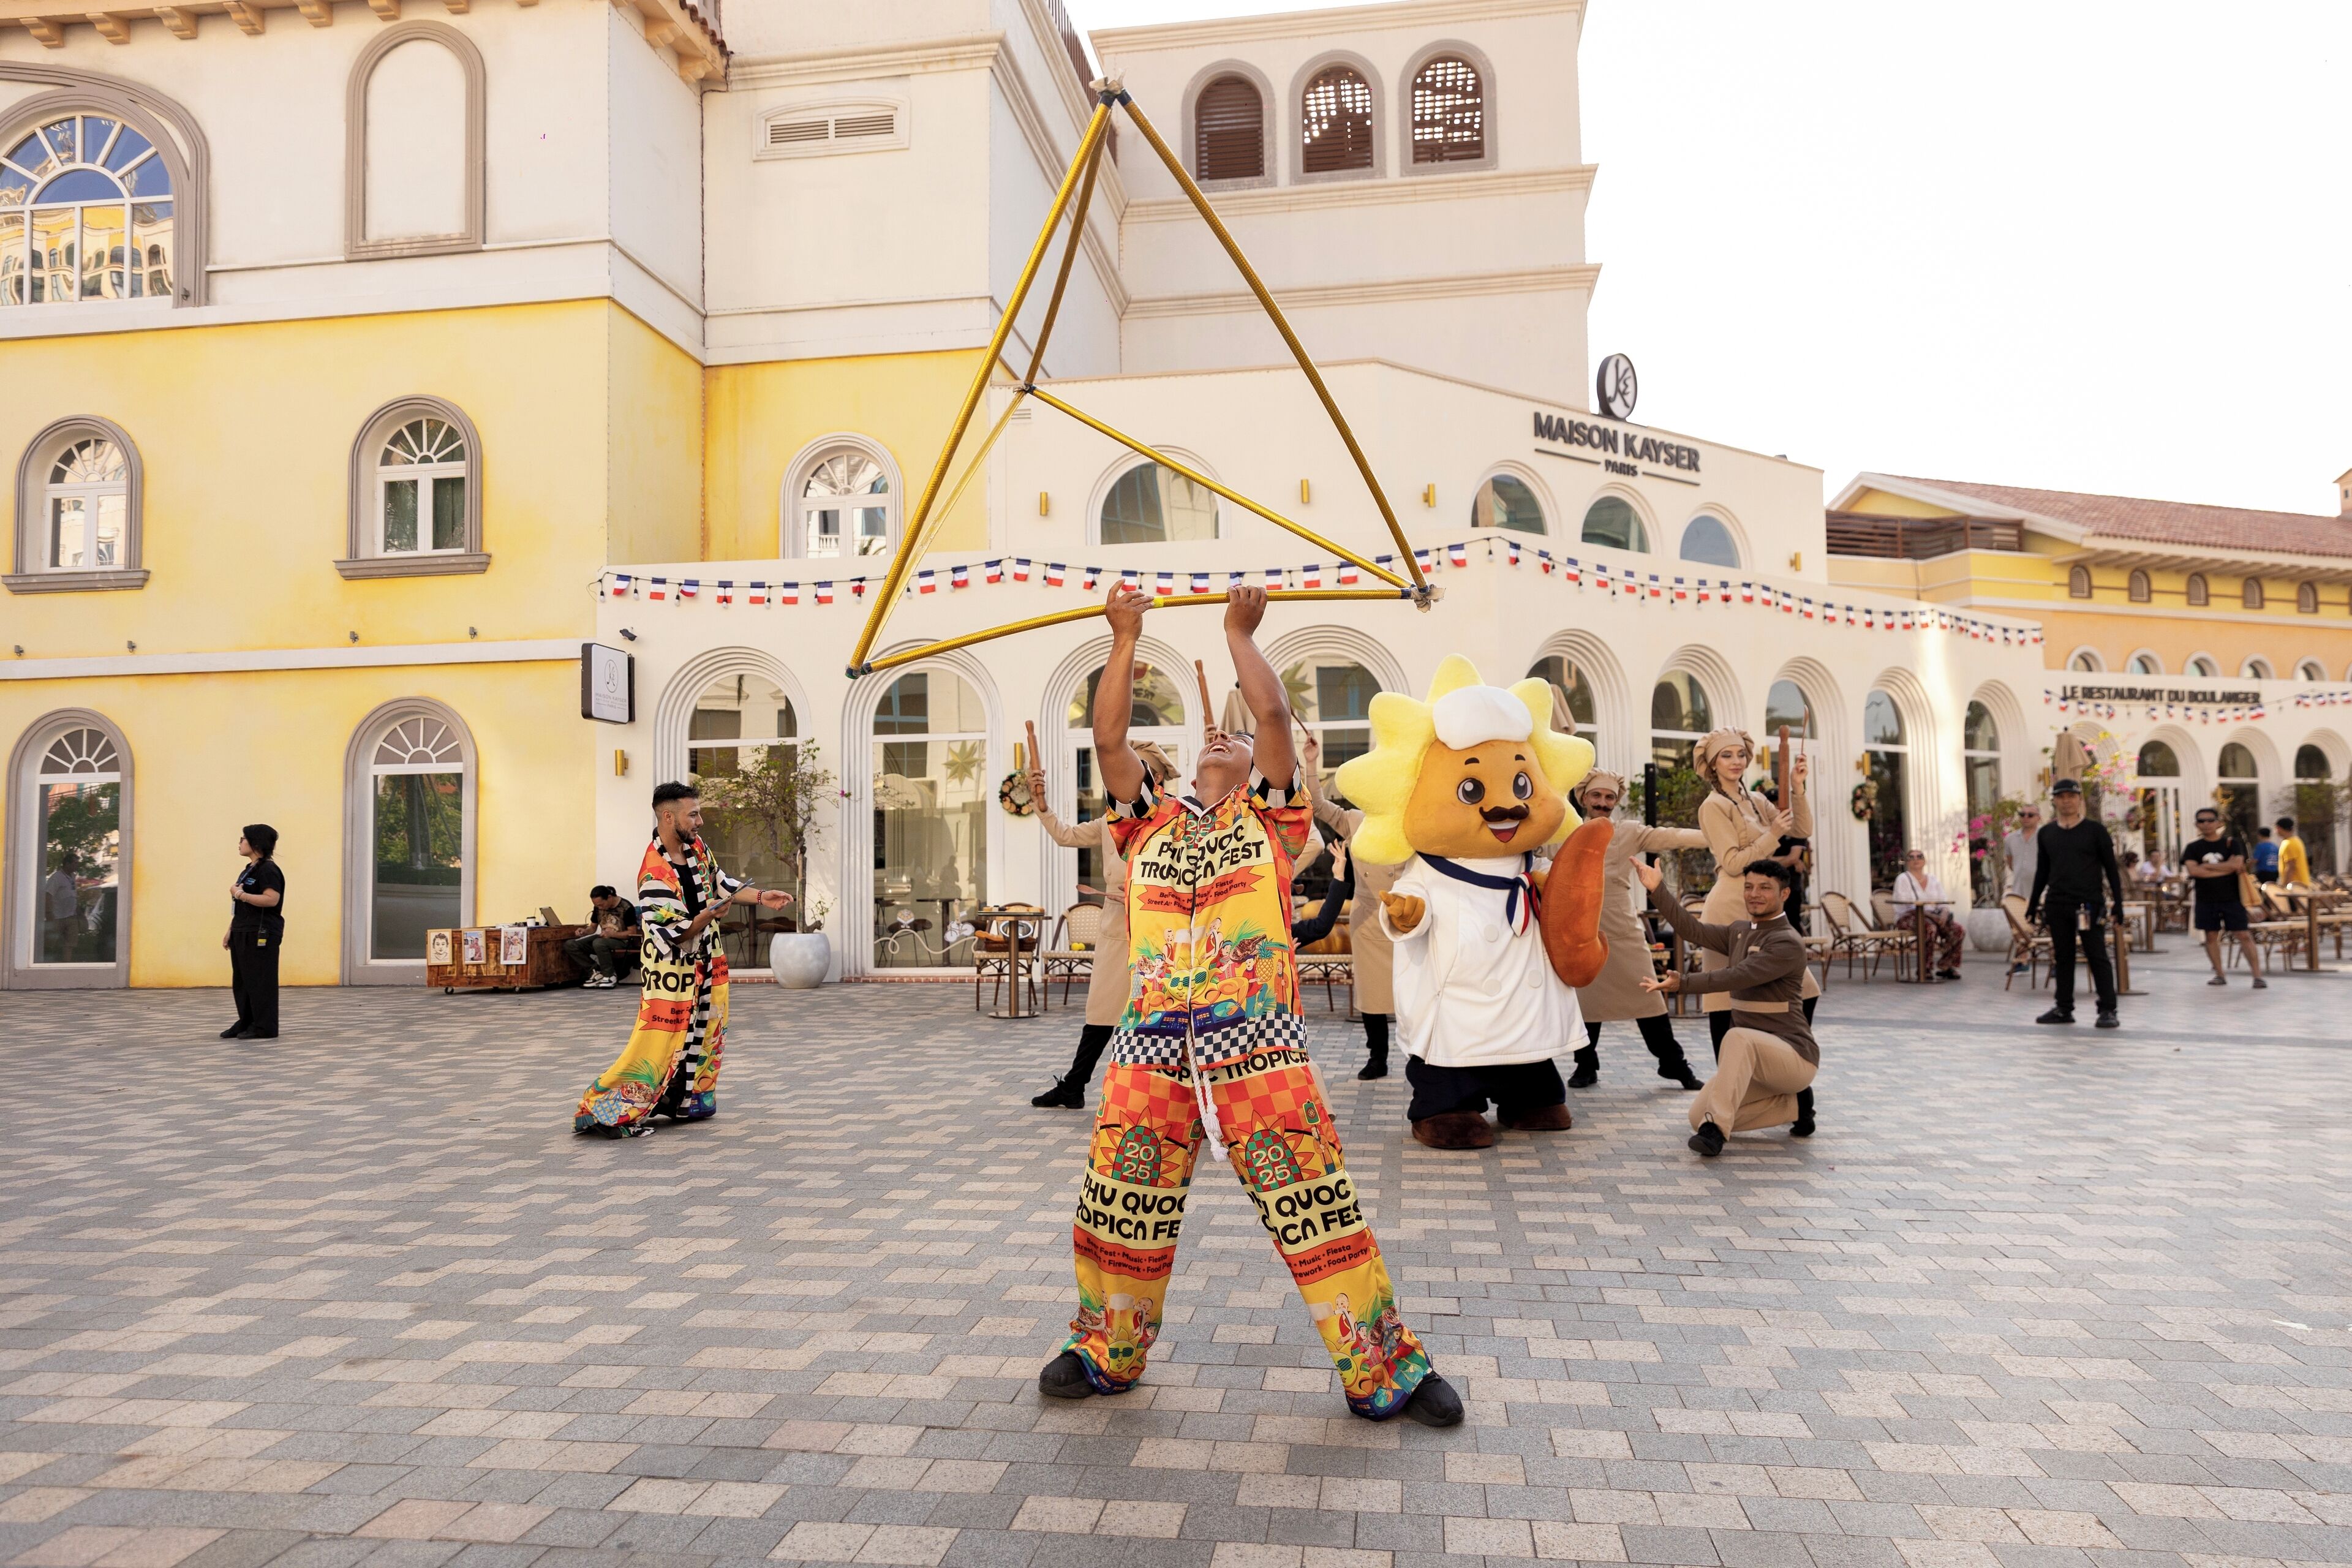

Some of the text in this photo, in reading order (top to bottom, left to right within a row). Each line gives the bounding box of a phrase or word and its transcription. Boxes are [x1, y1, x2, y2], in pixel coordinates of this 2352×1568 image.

[1534, 411, 1701, 472] MAISON KAYSER
[1604, 459, 1638, 477] PARIS
[2062, 685, 2261, 704] LE RESTAURANT DU BOULANGER
[1218, 840, 1264, 869] FEST
[1214, 888, 1229, 897] Food
[1229, 882, 1247, 891] Party
[1215, 879, 1234, 889] Fiesta
[1125, 1142, 1155, 1161] 20
[1252, 1145, 1284, 1167] 20
[1122, 1161, 1150, 1180] 25
[1259, 1164, 1291, 1186] 25
[1083, 1172, 1118, 1207] PHU
[1275, 1178, 1351, 1218] QUOC
[1087, 1237, 1168, 1264] Beer Fest Music Fiesta
[1298, 1254, 1322, 1267] Music
[1326, 1244, 1351, 1256] Fiesta
[1327, 1256, 1347, 1267] Food
[1348, 1246, 1368, 1261] Party
[1108, 1260, 1141, 1273] Firework
[1147, 1265, 1161, 1273] Food
